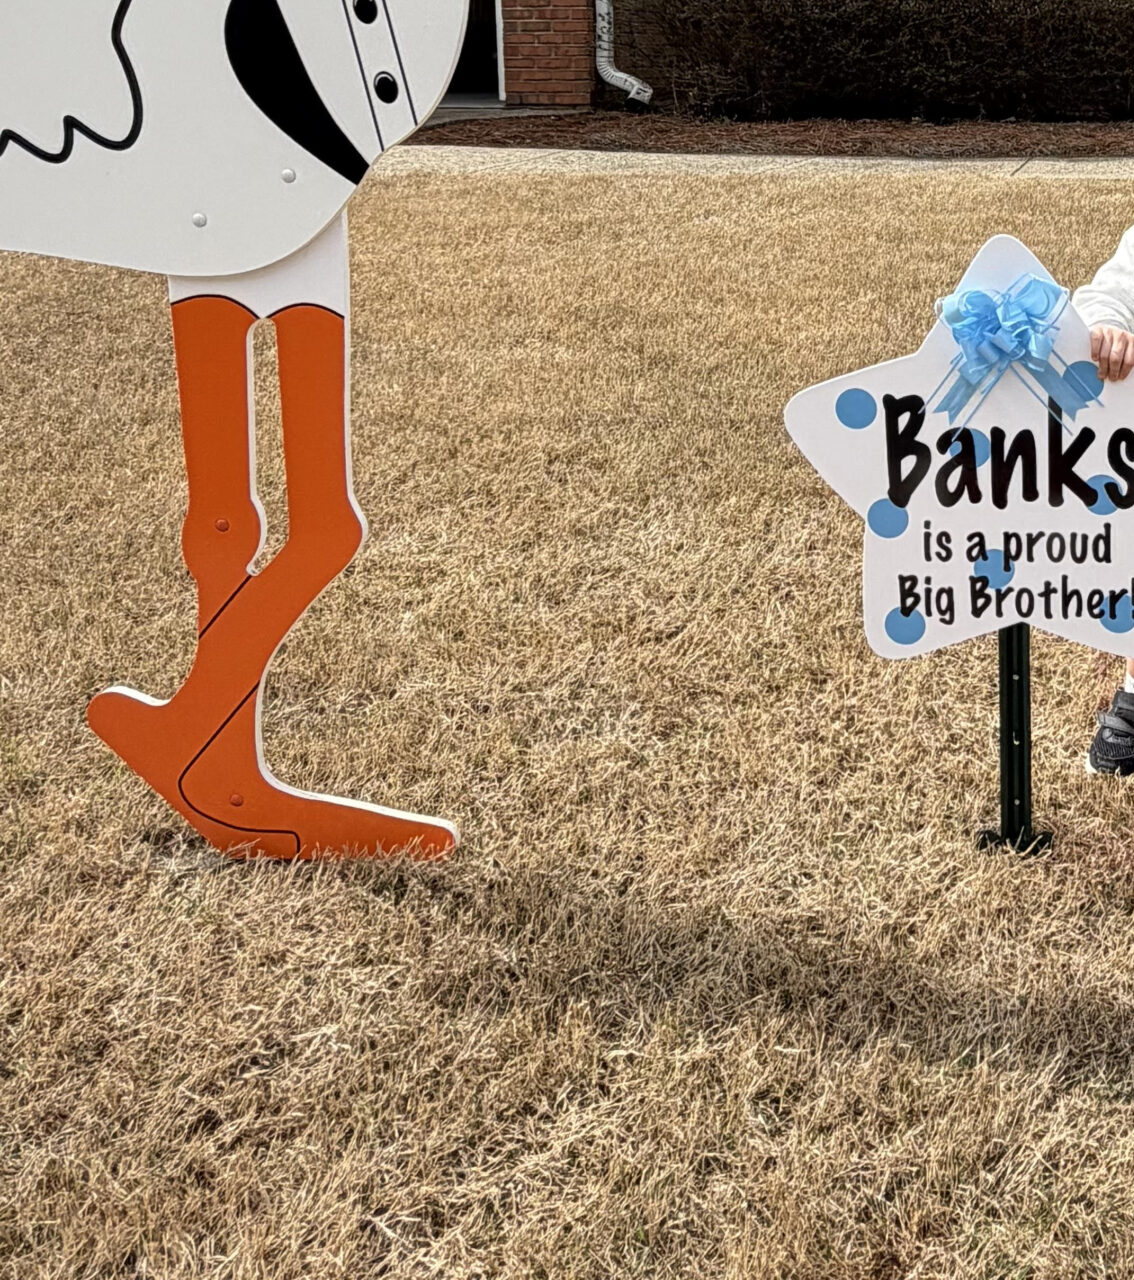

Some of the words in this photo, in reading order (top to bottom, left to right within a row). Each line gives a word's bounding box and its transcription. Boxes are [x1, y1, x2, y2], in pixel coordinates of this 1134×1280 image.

[923, 520, 953, 562] is
[965, 531, 989, 563] a
[1003, 522, 1112, 572] proud
[898, 574, 955, 625] Big
